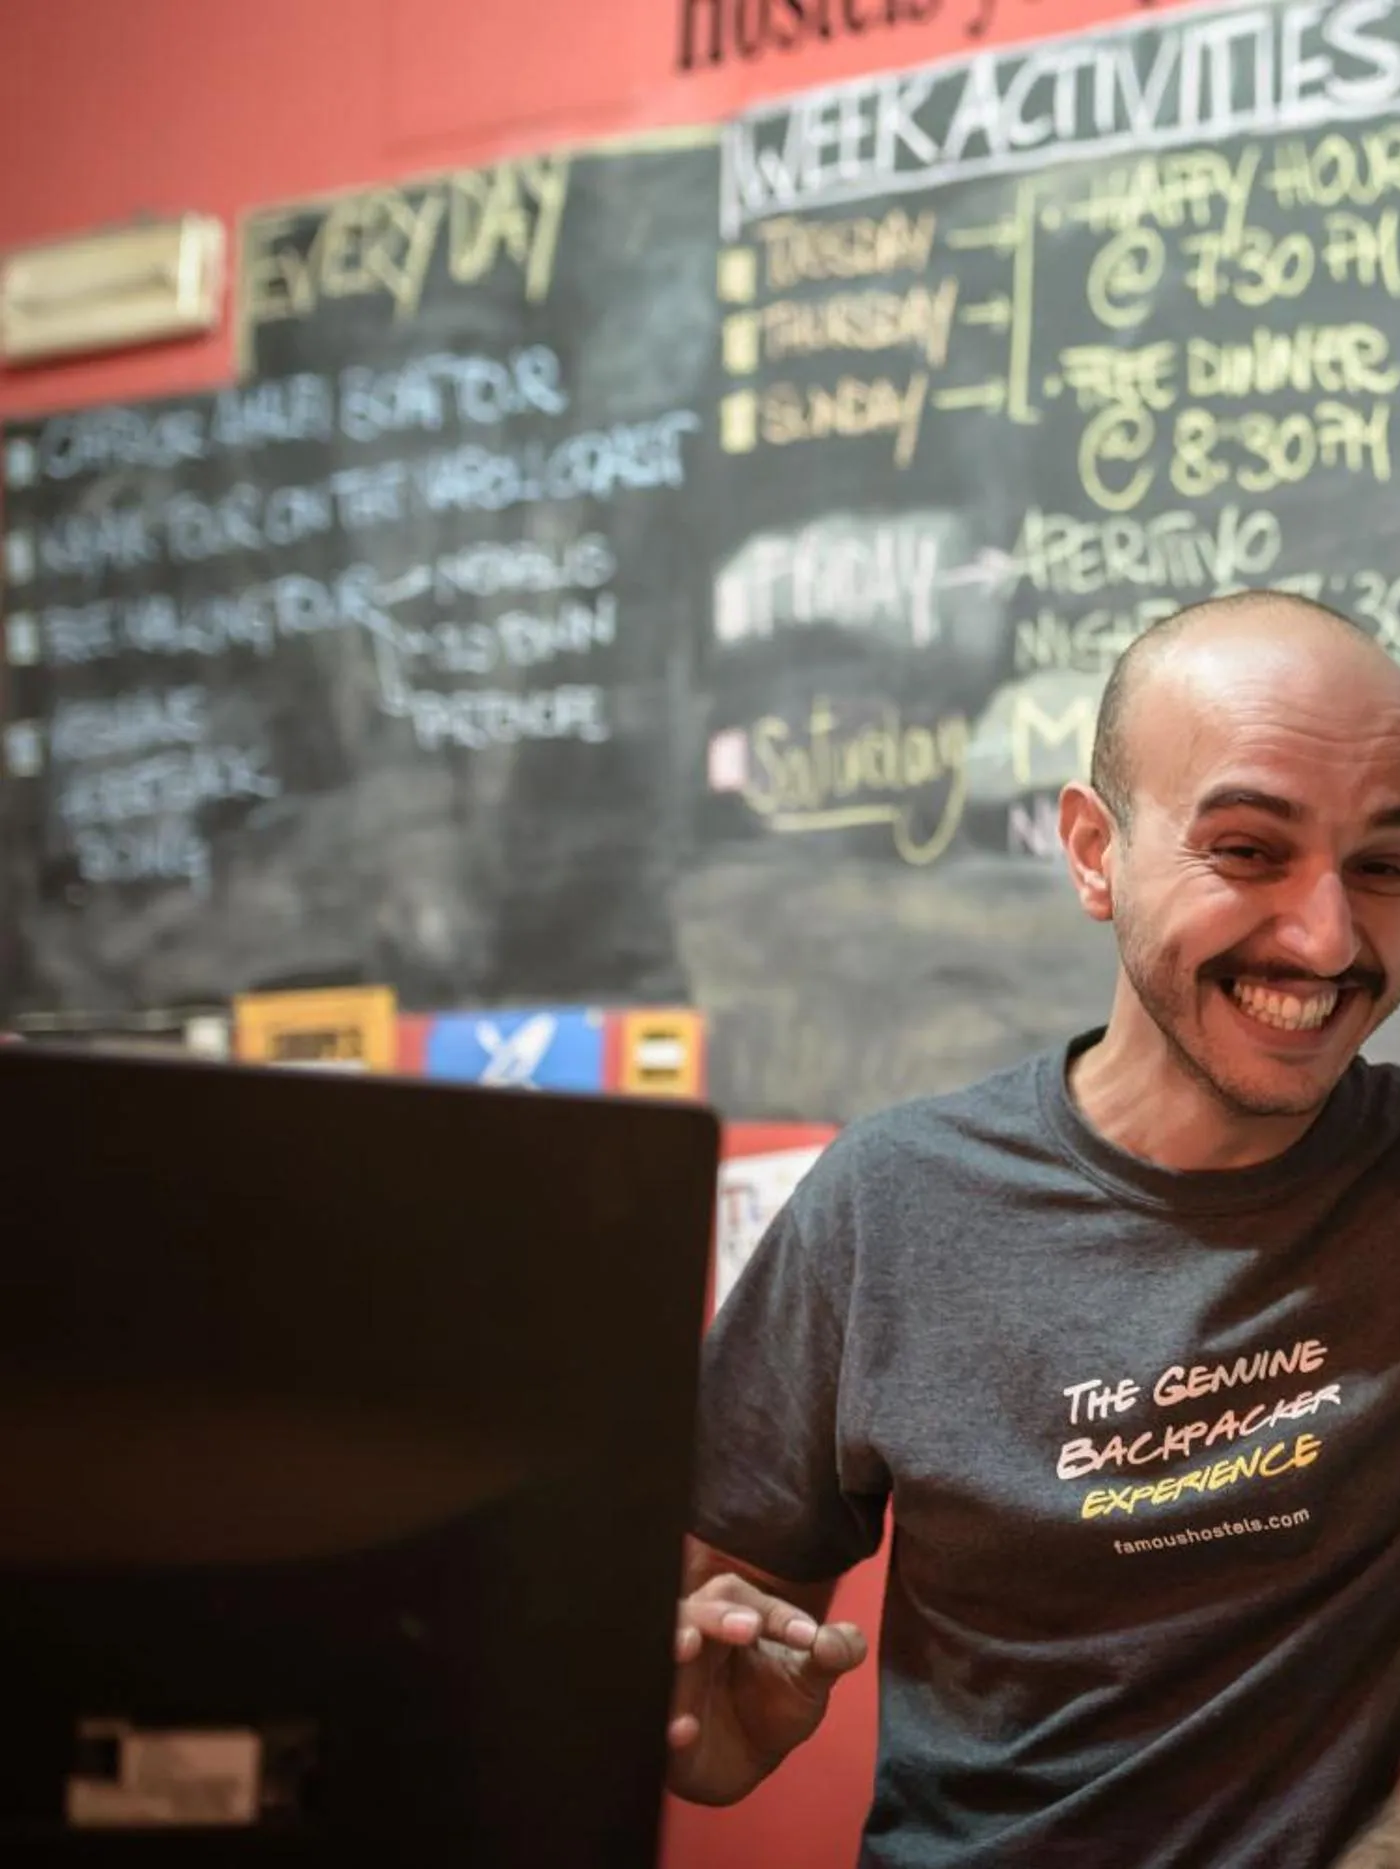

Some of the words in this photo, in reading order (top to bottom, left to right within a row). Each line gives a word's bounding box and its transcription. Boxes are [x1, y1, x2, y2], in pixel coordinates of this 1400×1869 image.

[1063, 1379, 1141, 1424] THE
[1153, 1340, 1328, 1406] GENUINE
[1056, 1383, 1342, 1480] BACKPACKER
[1081, 1433, 1322, 1519] EXPERIENCE
[1113, 1507, 1310, 1554] famoushostels.com
